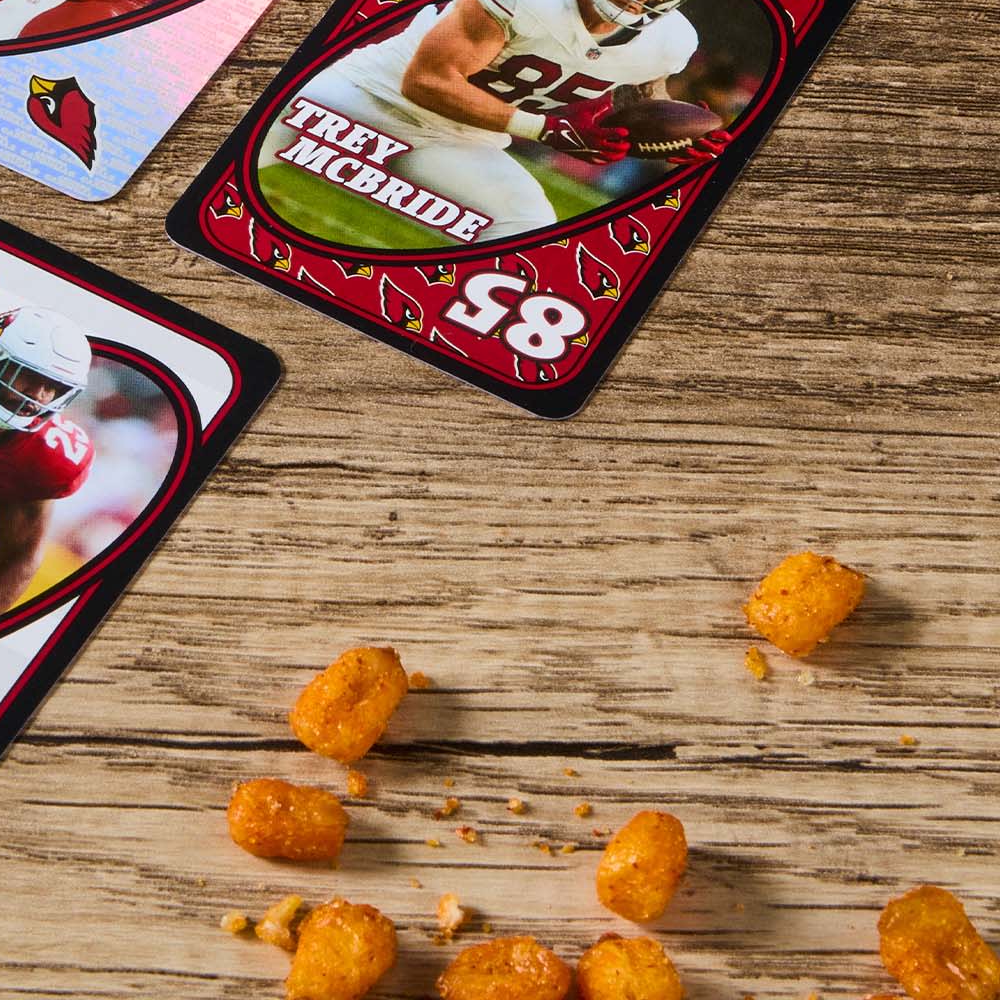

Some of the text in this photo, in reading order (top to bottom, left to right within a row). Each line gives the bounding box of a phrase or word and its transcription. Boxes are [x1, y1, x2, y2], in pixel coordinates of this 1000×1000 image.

[467, 54, 616, 116] 85
[284, 98, 411, 166] TREY
[277, 135, 491, 243] MCBRIDE
[442, 270, 588, 362] 85
